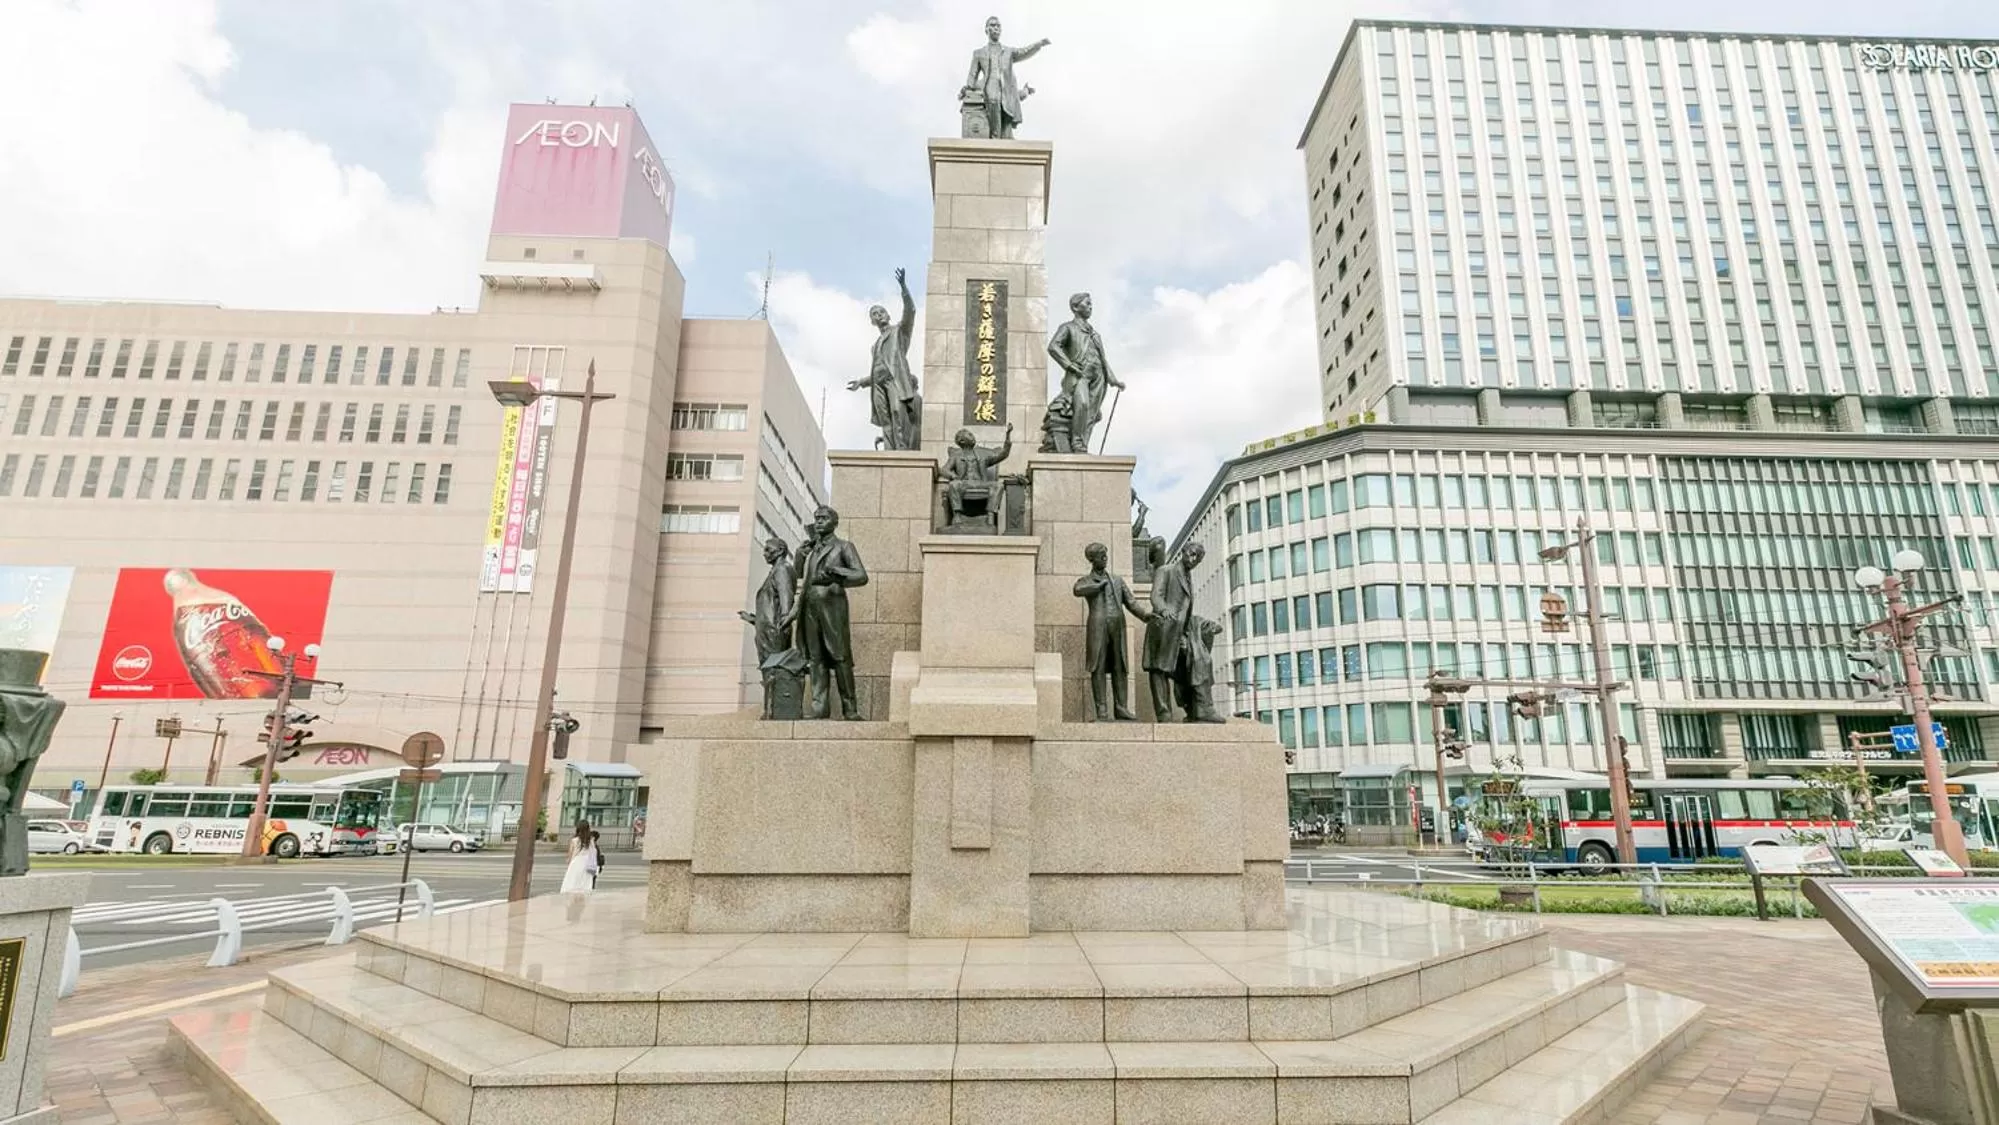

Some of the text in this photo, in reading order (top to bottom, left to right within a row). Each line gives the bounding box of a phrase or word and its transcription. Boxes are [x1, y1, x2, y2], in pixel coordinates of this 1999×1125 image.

[1861, 44, 1952, 69] SOLARIA
[974, 283, 998, 421] 若き薩摩の群像
